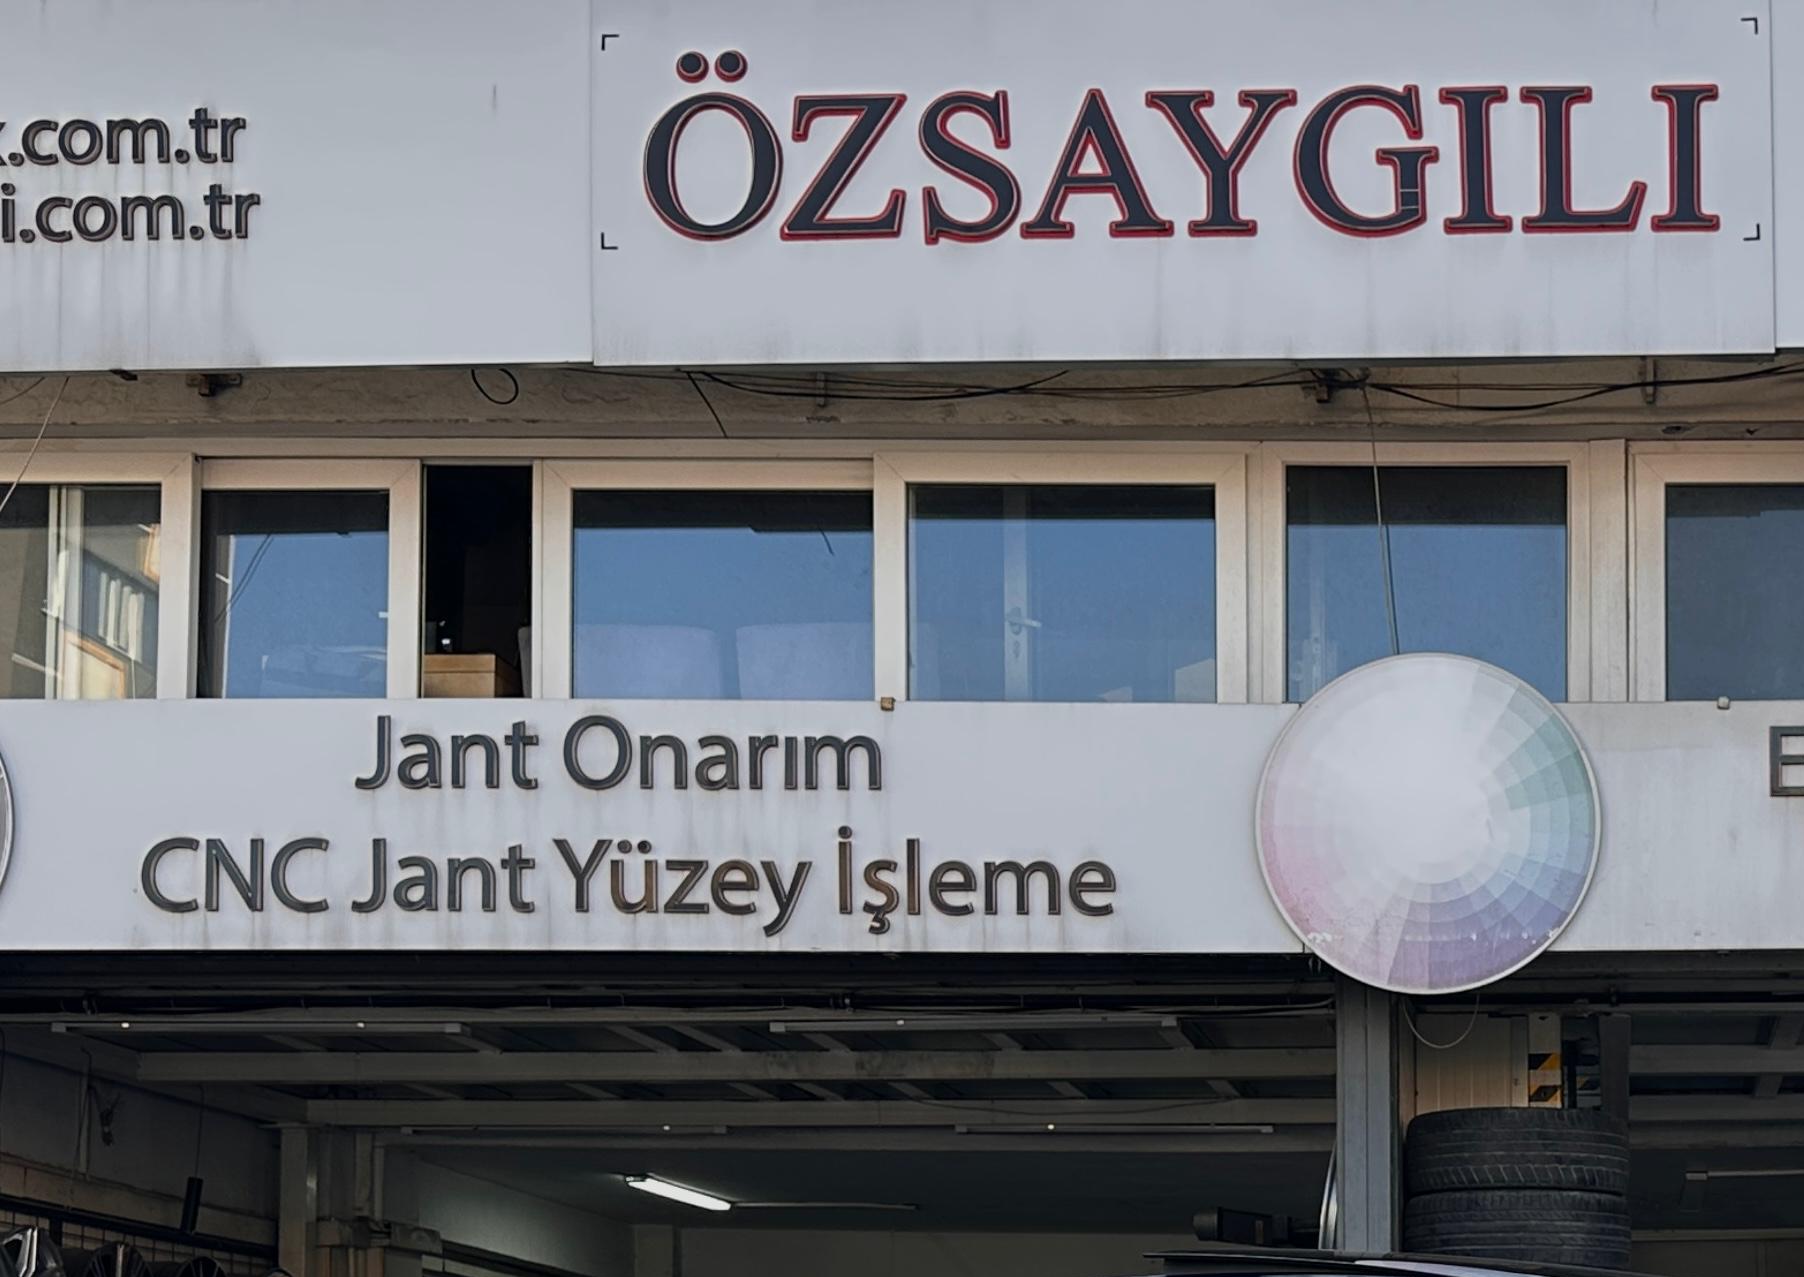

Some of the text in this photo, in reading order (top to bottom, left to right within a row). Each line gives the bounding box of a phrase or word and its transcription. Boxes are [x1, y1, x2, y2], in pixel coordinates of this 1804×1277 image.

[643, 51, 1720, 245] ÖZSAYGILI
[1, 183, 261, 243] i.com.tr
[355, 714, 882, 791] Jant Onarım
[142, 826, 1116, 937] CNC Jant Yüzey İşleme
